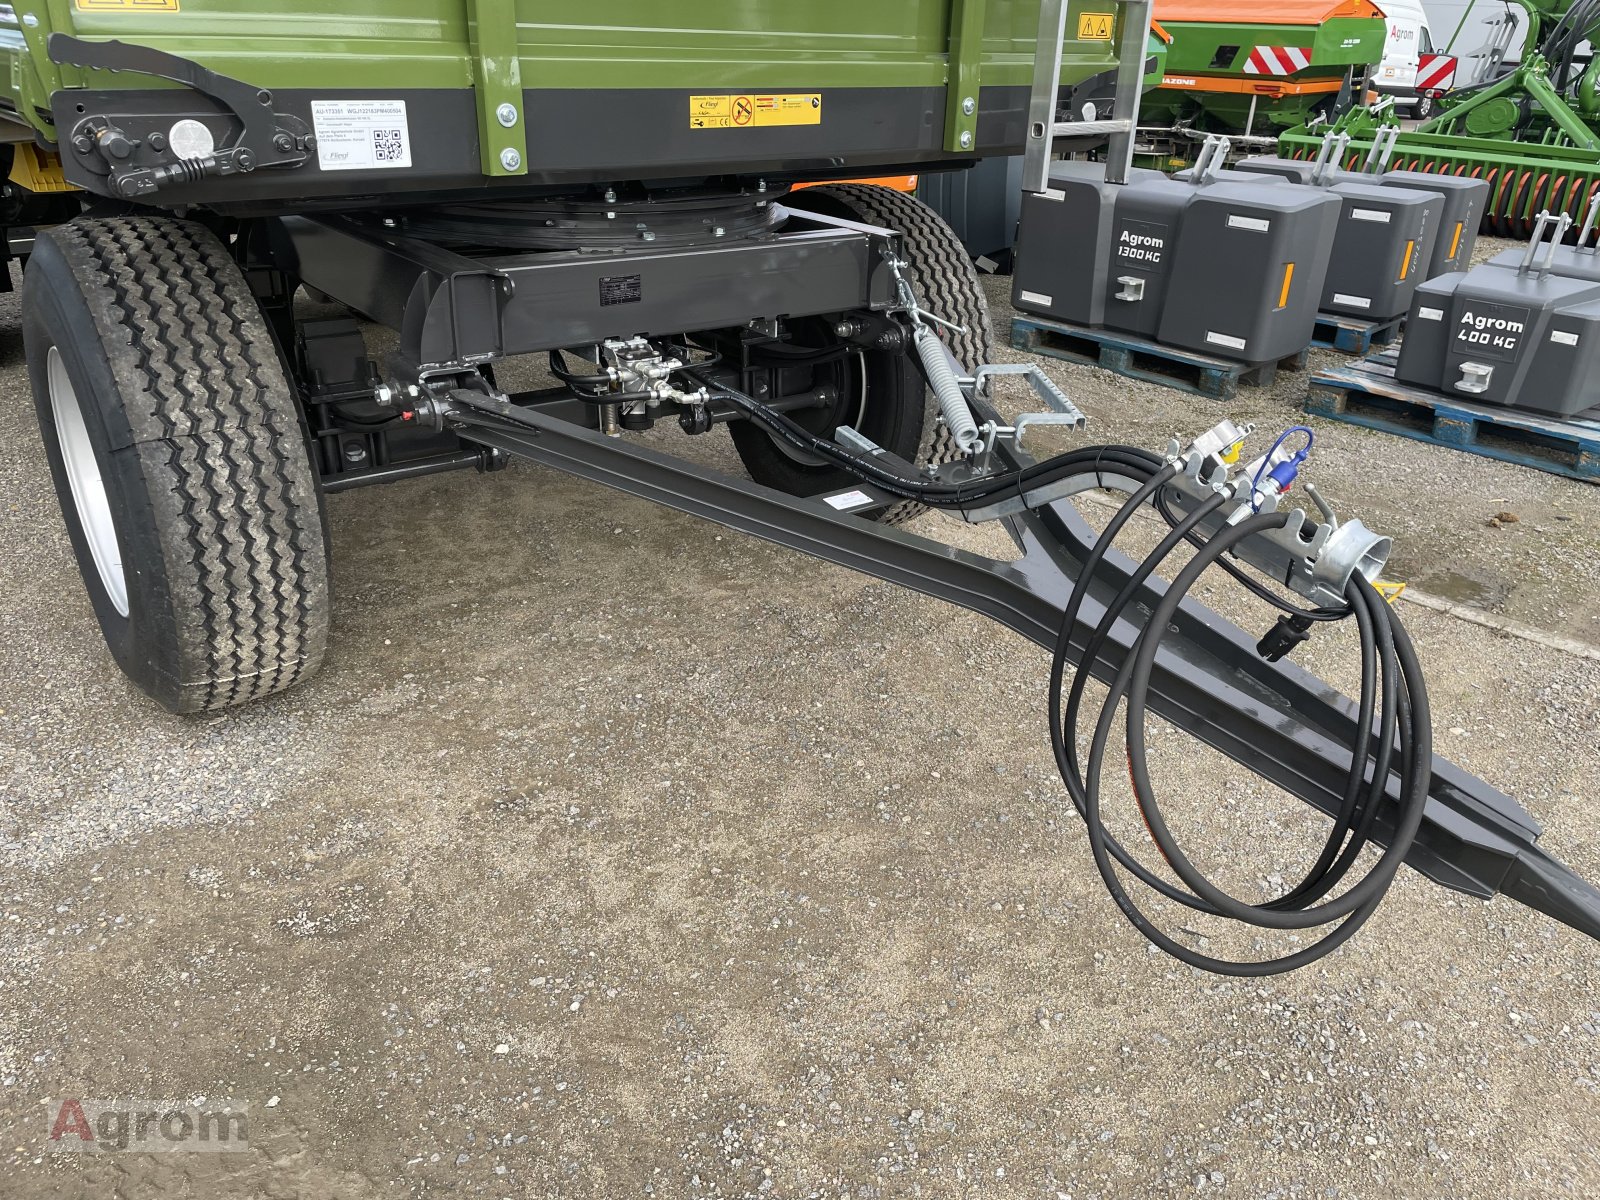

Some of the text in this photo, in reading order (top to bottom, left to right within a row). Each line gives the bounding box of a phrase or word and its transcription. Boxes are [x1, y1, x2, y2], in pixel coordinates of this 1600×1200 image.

[1390, 24, 1414, 42] Agrom
[1120, 230, 1164, 248] Agrom
[1118, 246, 1161, 263] 1300 KG
[1461, 311, 1524, 333] Agrom
[1457, 329, 1516, 349] 400 KG
